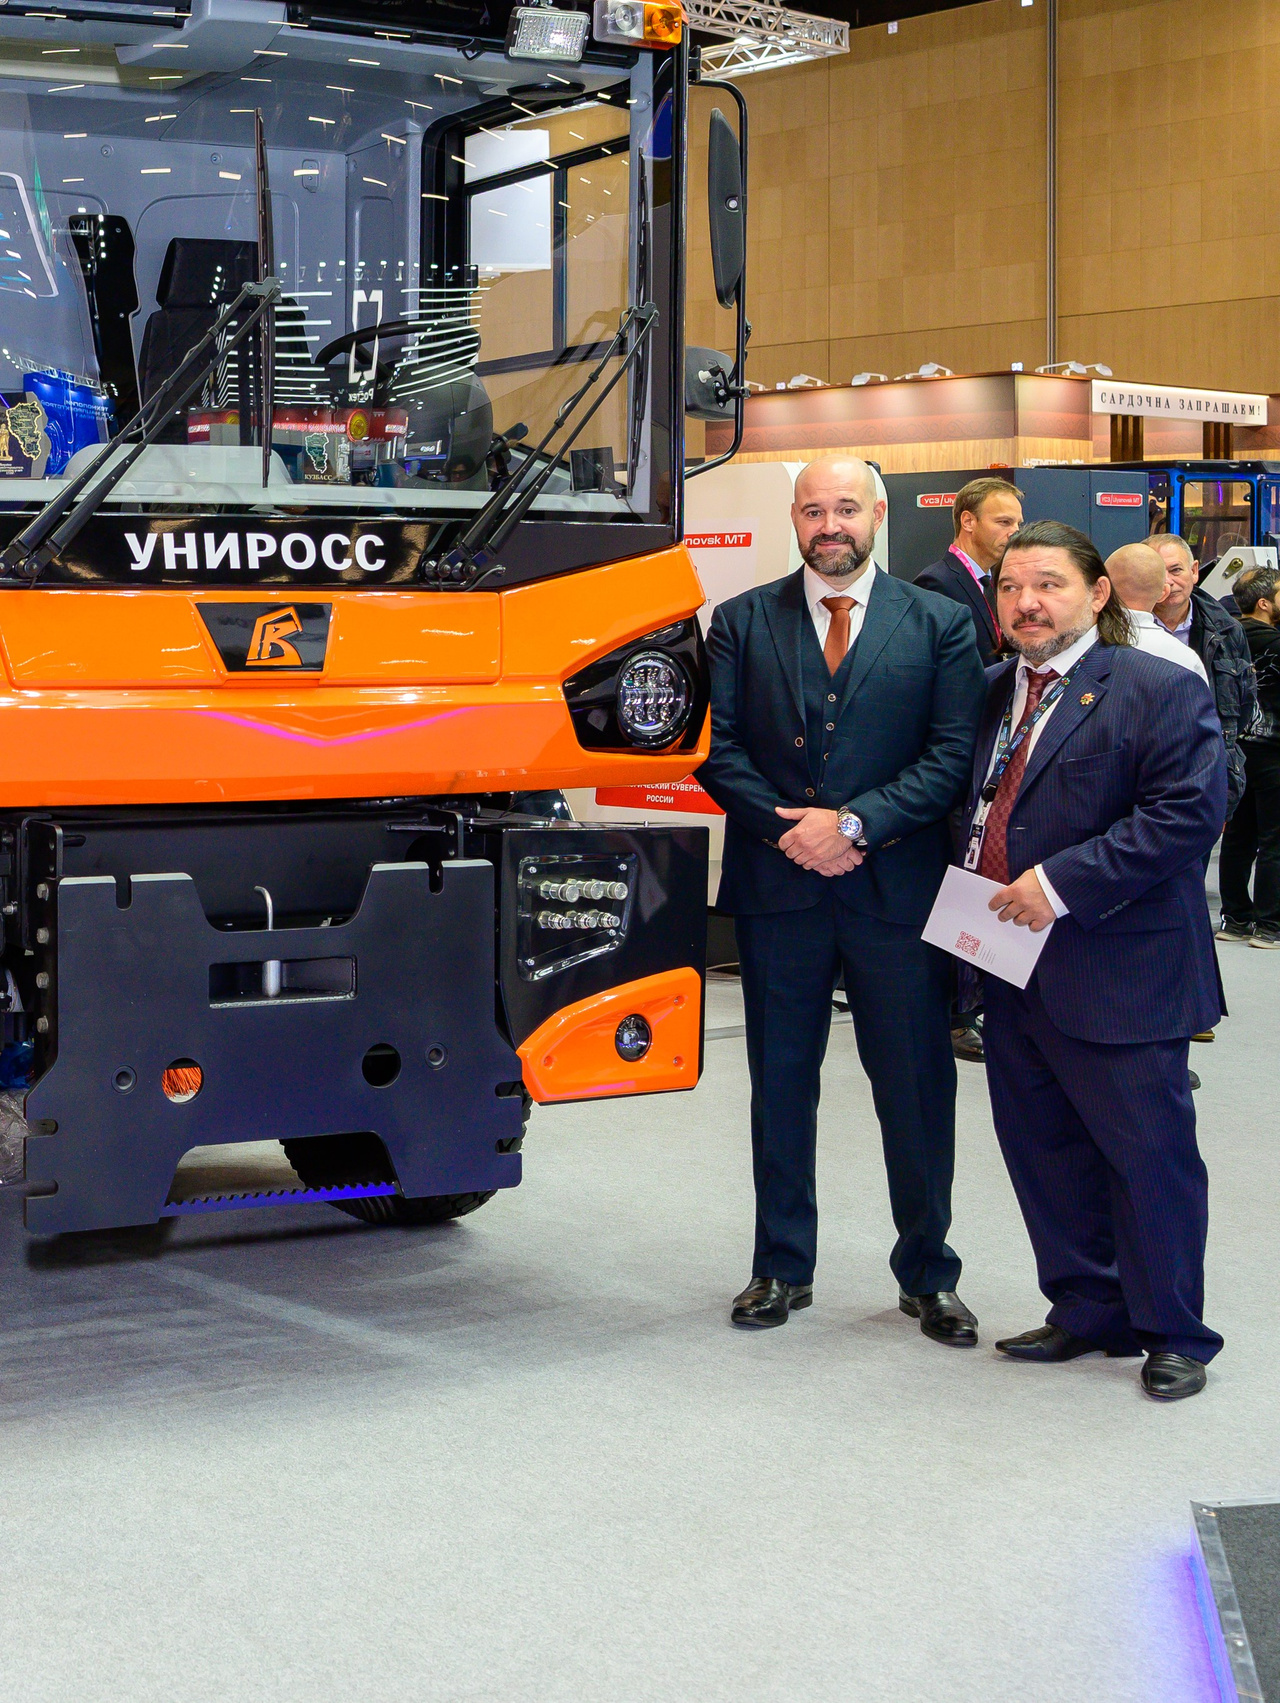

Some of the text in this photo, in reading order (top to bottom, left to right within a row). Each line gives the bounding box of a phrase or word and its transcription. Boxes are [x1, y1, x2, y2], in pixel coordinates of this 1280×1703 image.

[1100, 392, 1261, 416] САРДЭЧНА ЗАПРАШАЕМ!
[683, 534, 746, 546] novsk MT
[124, 532, 386, 571] УНИРОСС
[646, 794, 674, 804] РОССИИ
